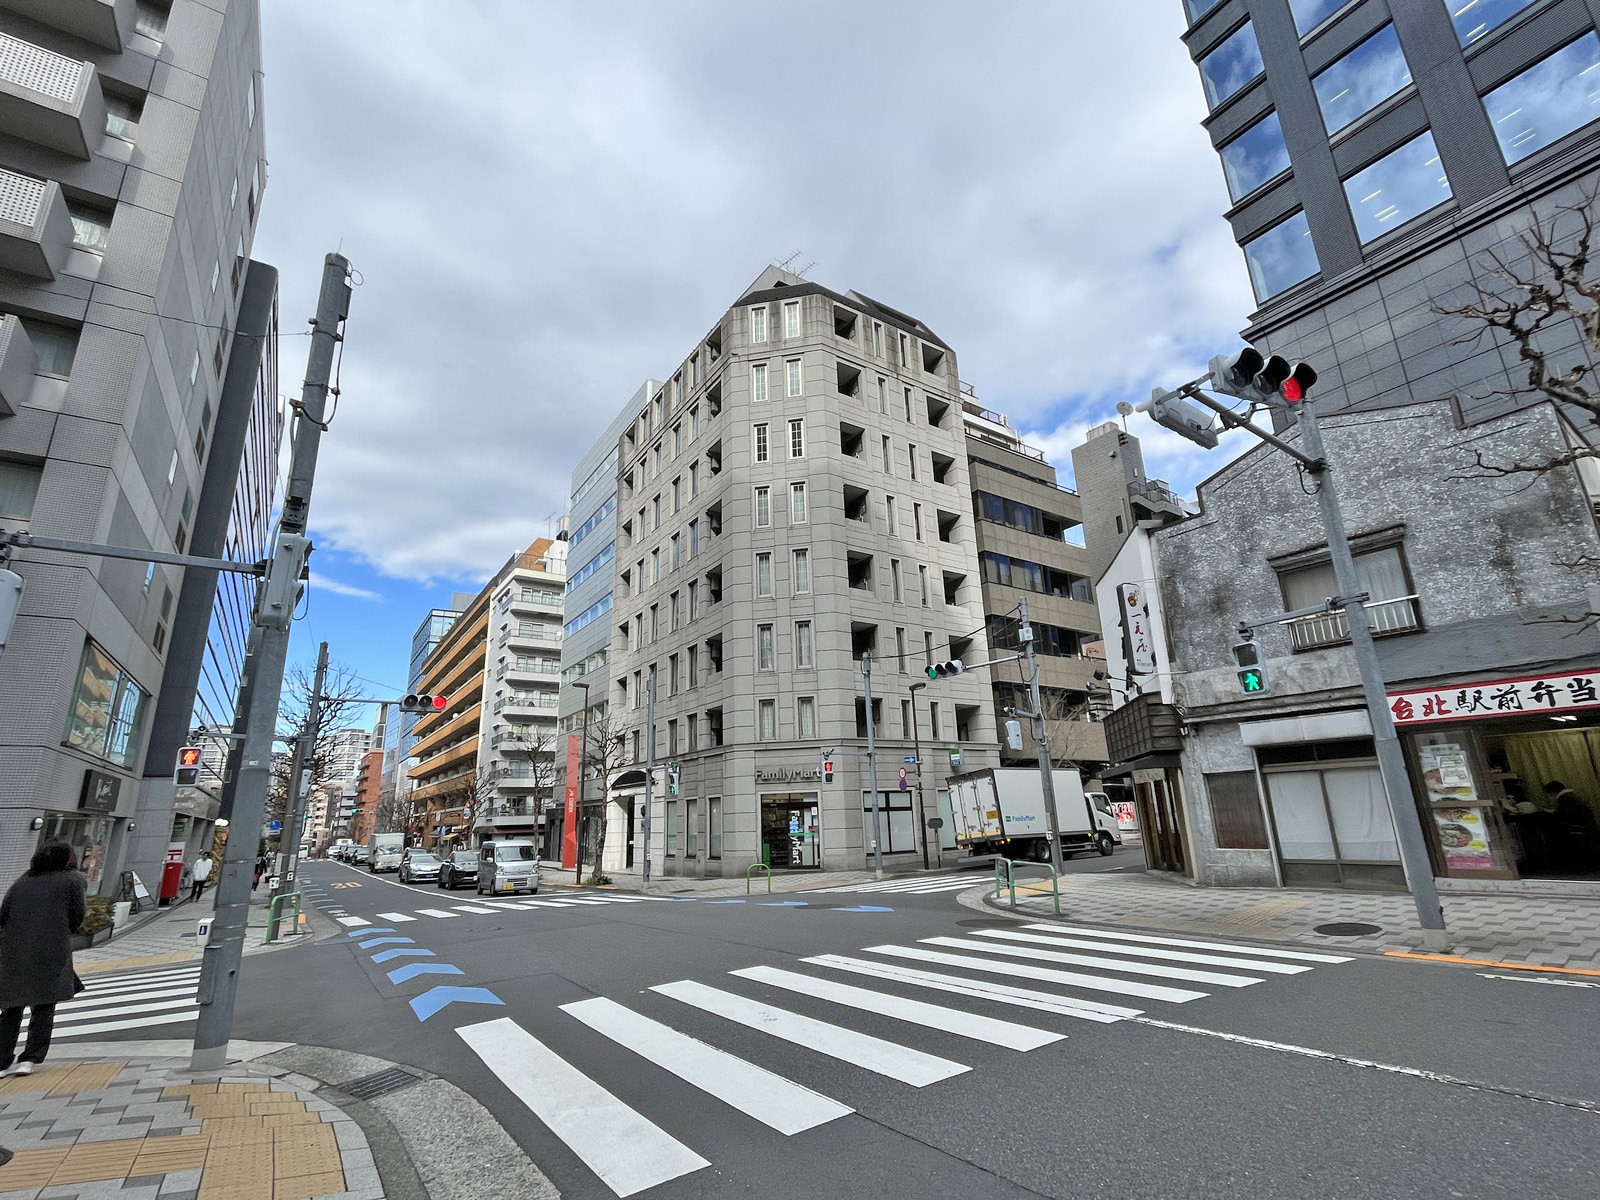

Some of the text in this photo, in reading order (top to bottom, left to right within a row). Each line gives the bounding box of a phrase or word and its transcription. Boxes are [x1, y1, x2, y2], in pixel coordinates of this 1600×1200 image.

[1391, 677, 1599, 721] 台北駅前弁当
[755, 766, 822, 783] FamilyMart
[789, 810, 802, 864] FayMart
